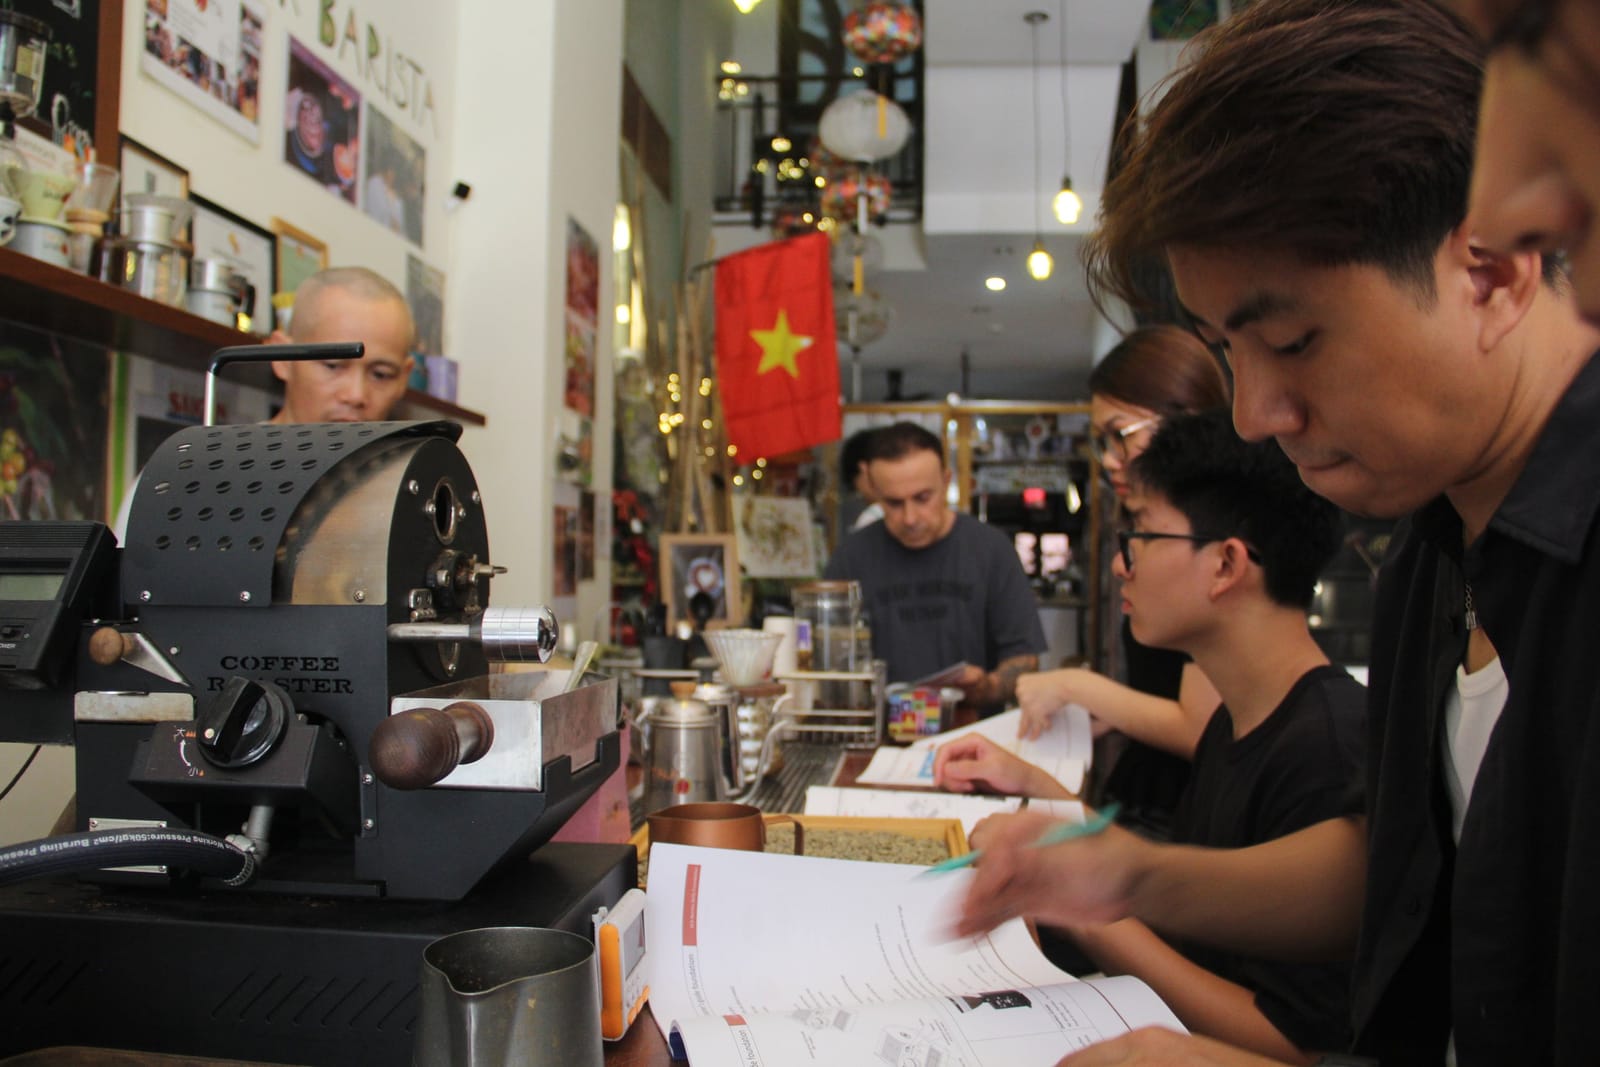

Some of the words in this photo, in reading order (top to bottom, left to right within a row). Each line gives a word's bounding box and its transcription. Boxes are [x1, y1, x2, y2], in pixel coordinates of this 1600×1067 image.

[318, 0, 441, 140] BARISTA
[220, 656, 340, 672] COFFEE
[207, 677, 354, 694] RSTER
[40, 837, 90, 853] Bursting
[193, 836, 225, 850] Working
